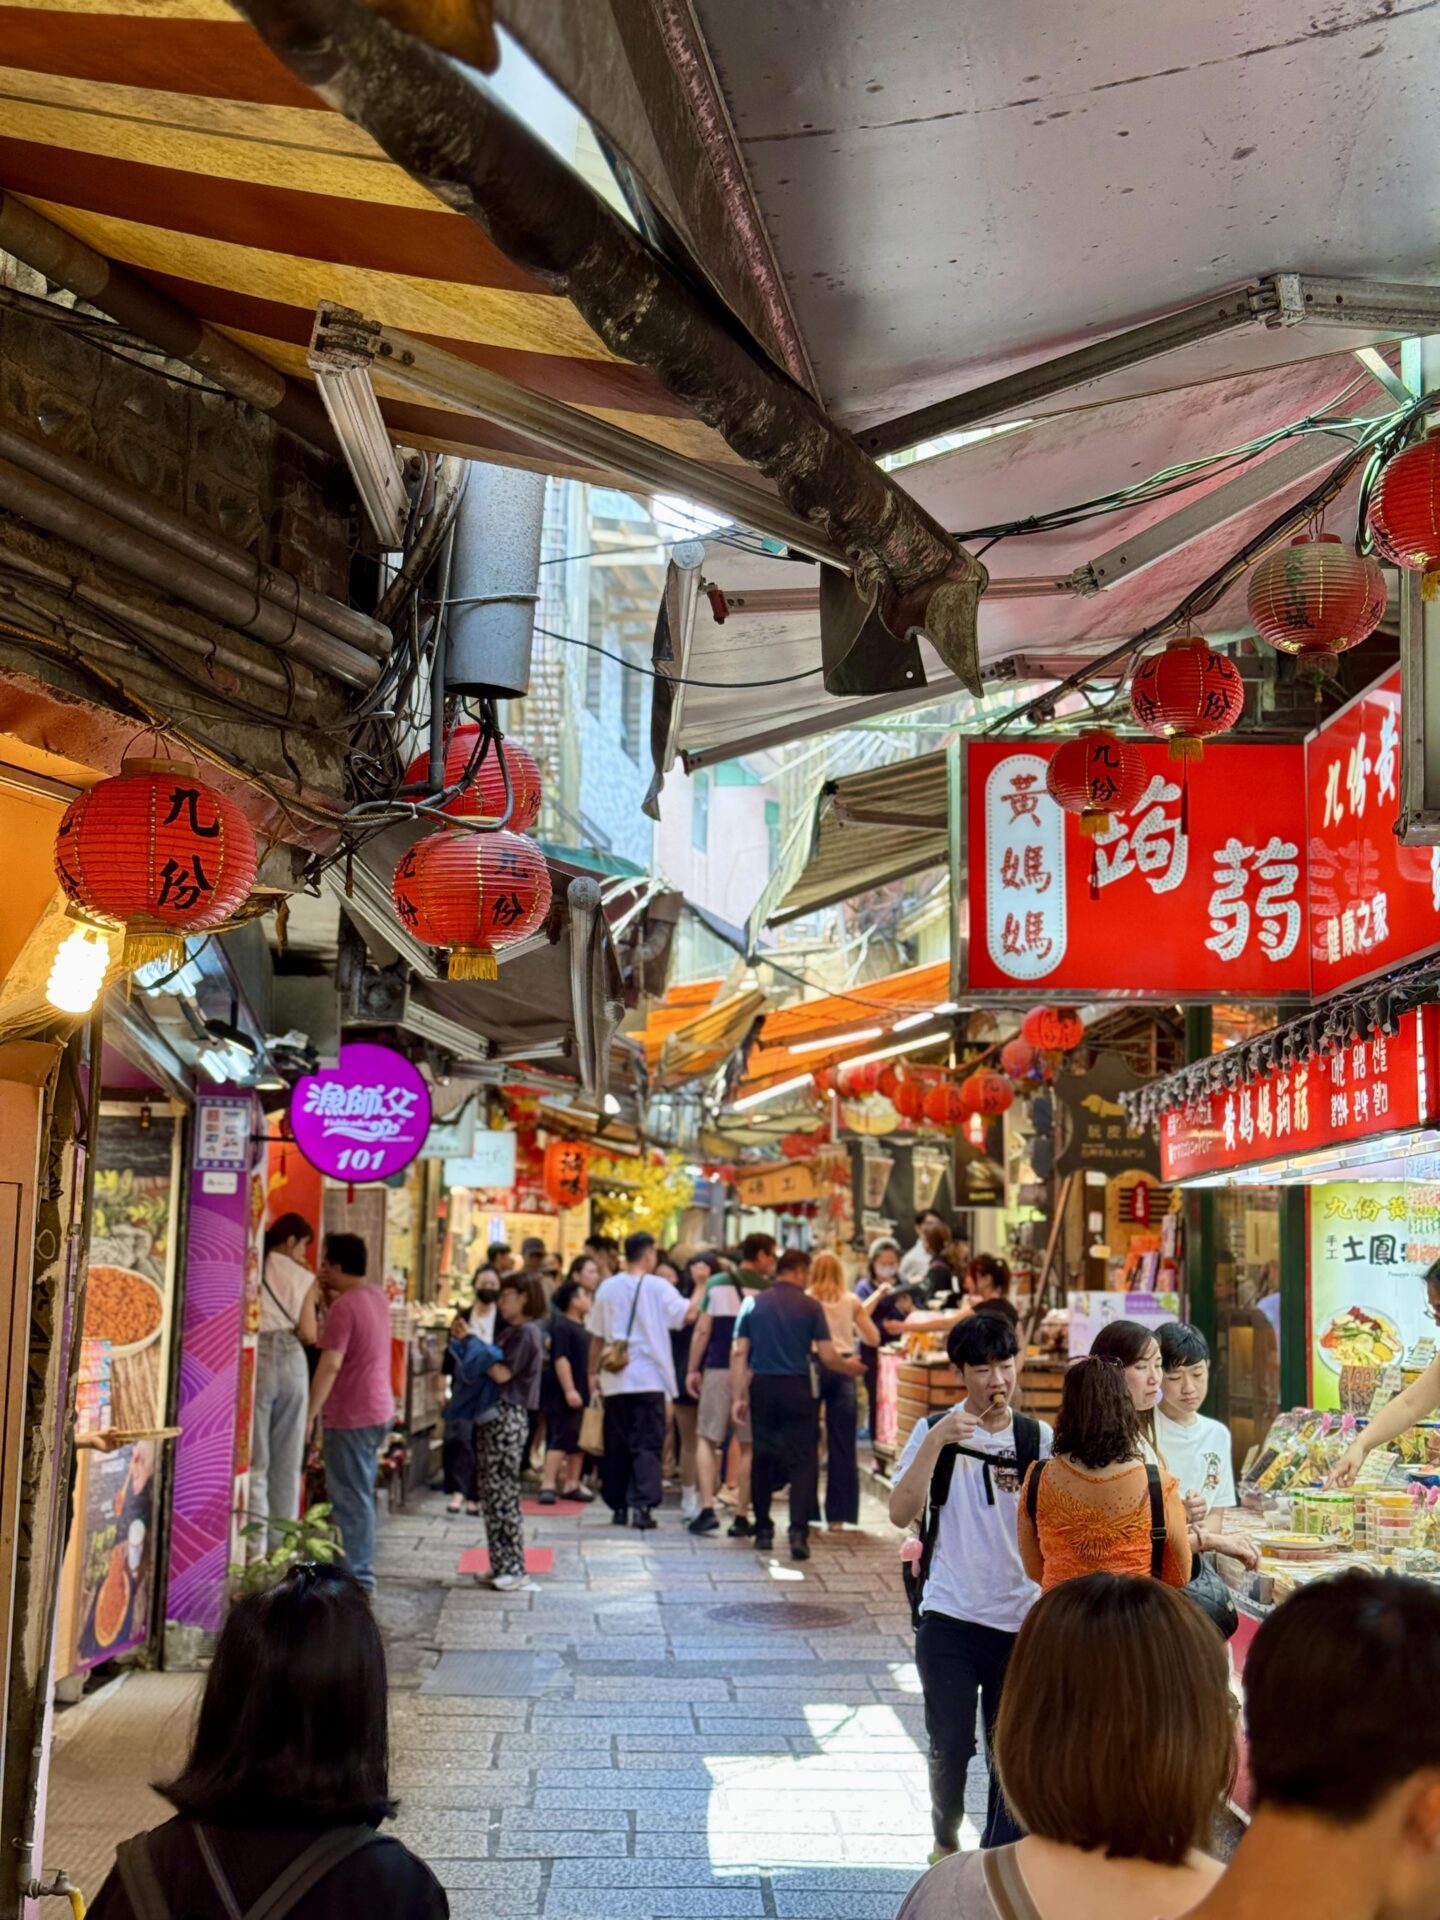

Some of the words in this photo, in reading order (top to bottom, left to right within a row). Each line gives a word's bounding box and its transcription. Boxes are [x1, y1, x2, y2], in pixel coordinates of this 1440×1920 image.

[1202, 655, 1233, 720] 九份
[1090, 744, 1121, 802] 九份
[157, 786, 220, 910] 九份
[1001, 774, 1052, 960] 黃媽媽
[1088, 774, 1301, 961] 蒟蒻
[492, 849, 529, 926] 九份
[304, 1081, 418, 1119] 漁師父
[1222, 1070, 1309, 1152] 黃媽媽蒟蒻
[337, 1149, 386, 1171] 101
[1326, 1234, 1339, 1260] 手工
[1343, 1234, 1407, 1265] 土鳳
